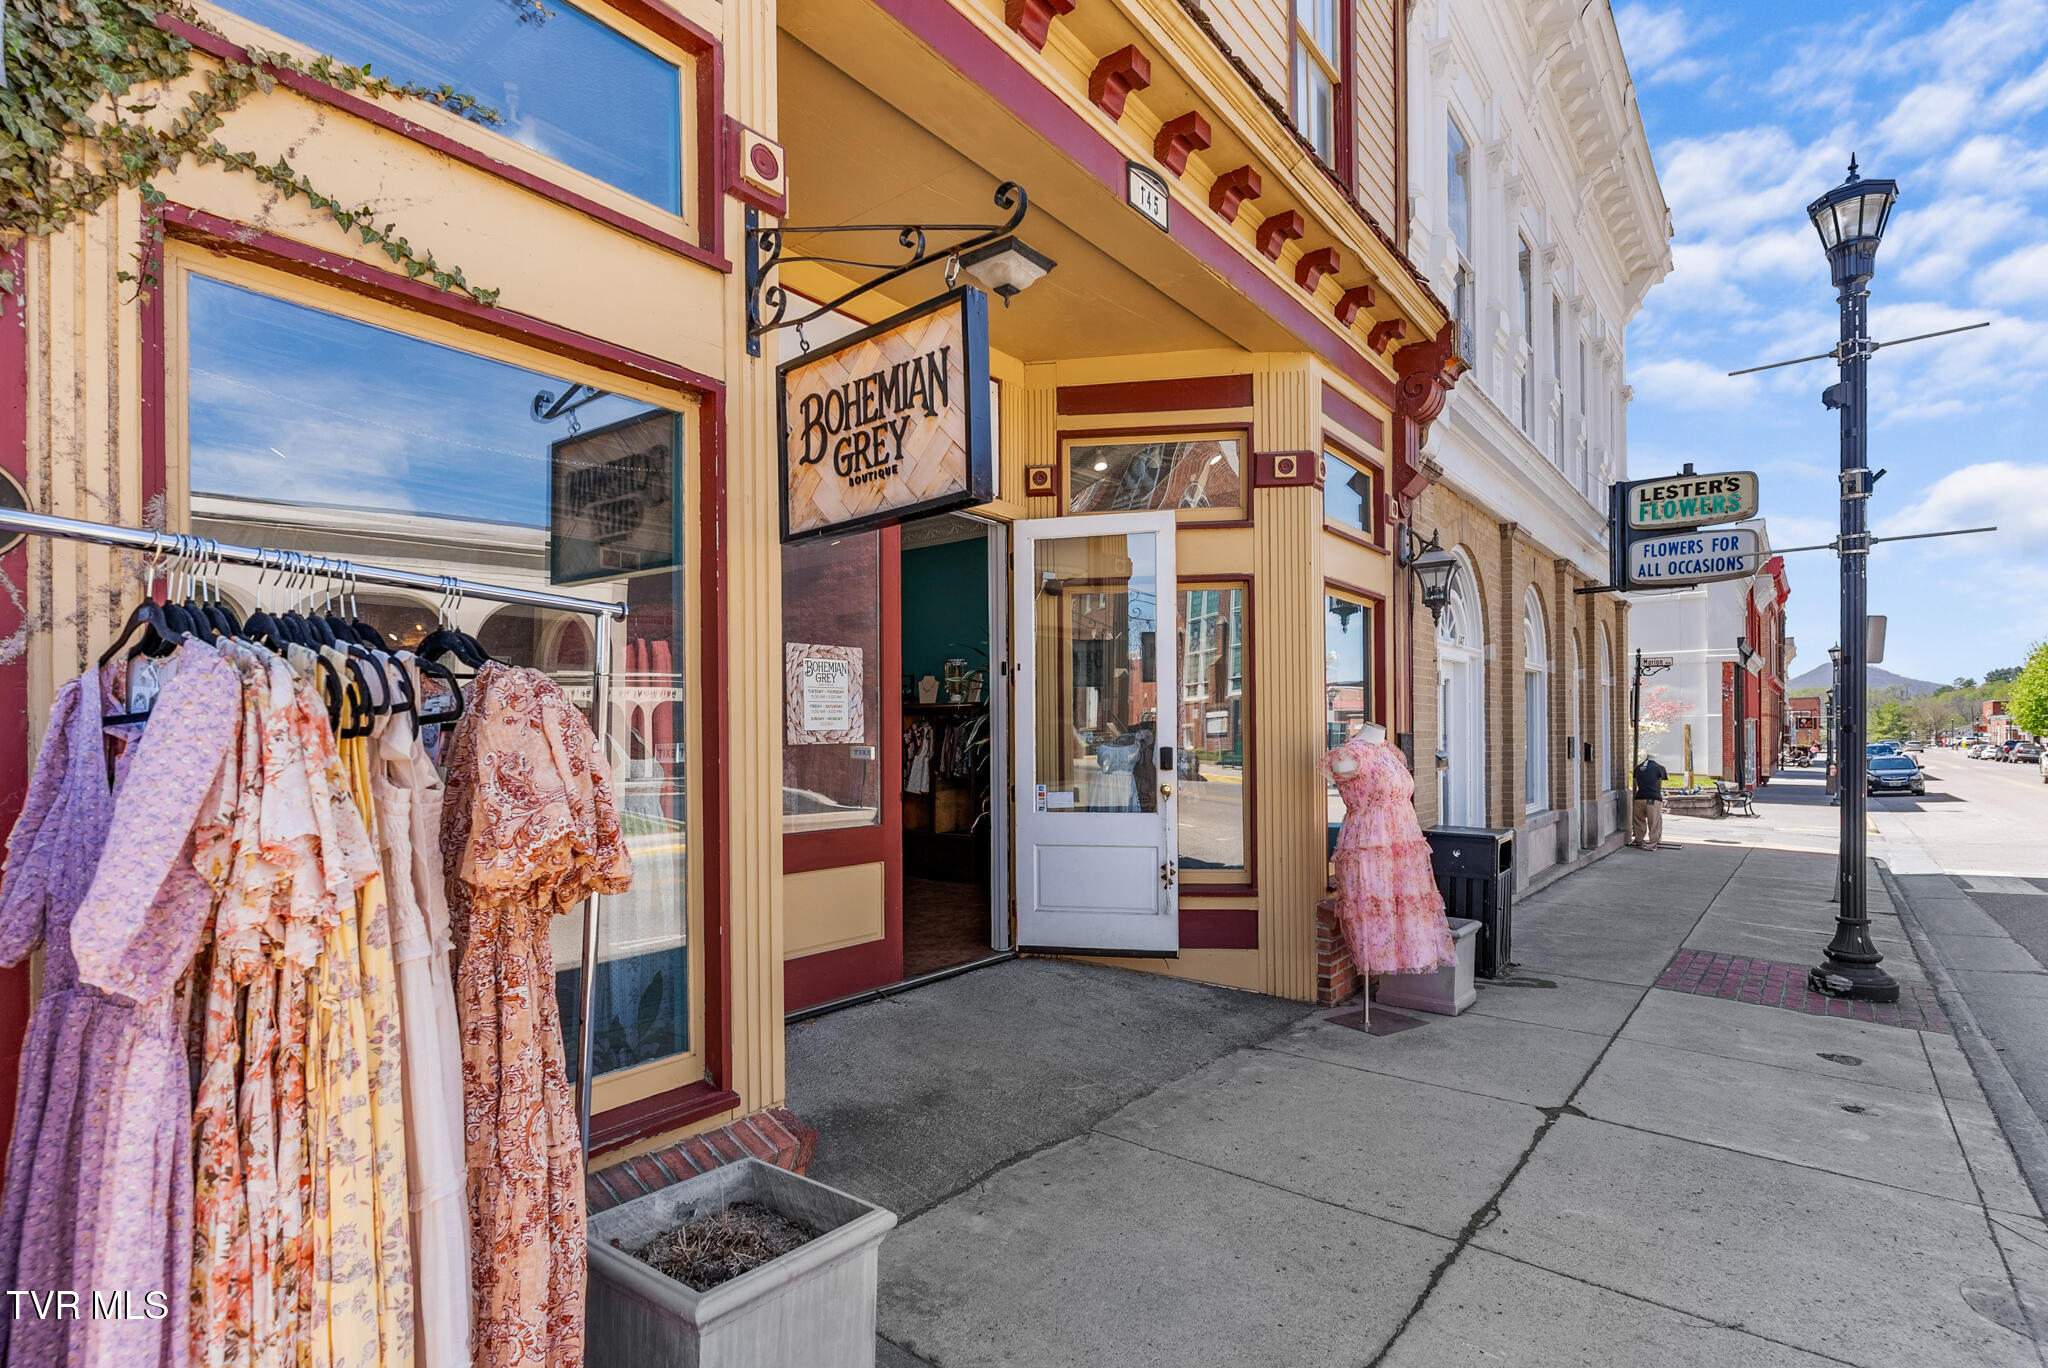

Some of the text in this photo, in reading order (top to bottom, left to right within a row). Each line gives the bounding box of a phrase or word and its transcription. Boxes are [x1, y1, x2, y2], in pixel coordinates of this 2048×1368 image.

[1140, 186, 1159, 215] 145
[799, 345, 951, 465] BOHEMIAN
[833, 415, 911, 477] GREY
[849, 464, 898, 487] BOUTIQUE
[1640, 476, 1740, 503] LESTER'S
[1639, 493, 1741, 522] FLOWERS
[1643, 535, 1739, 558] FLOWERS FOR
[1638, 556, 1744, 578] ALL OCCASIONS
[804, 660, 848, 677] BOHEMIAN
[815, 672, 837, 684] GREY
